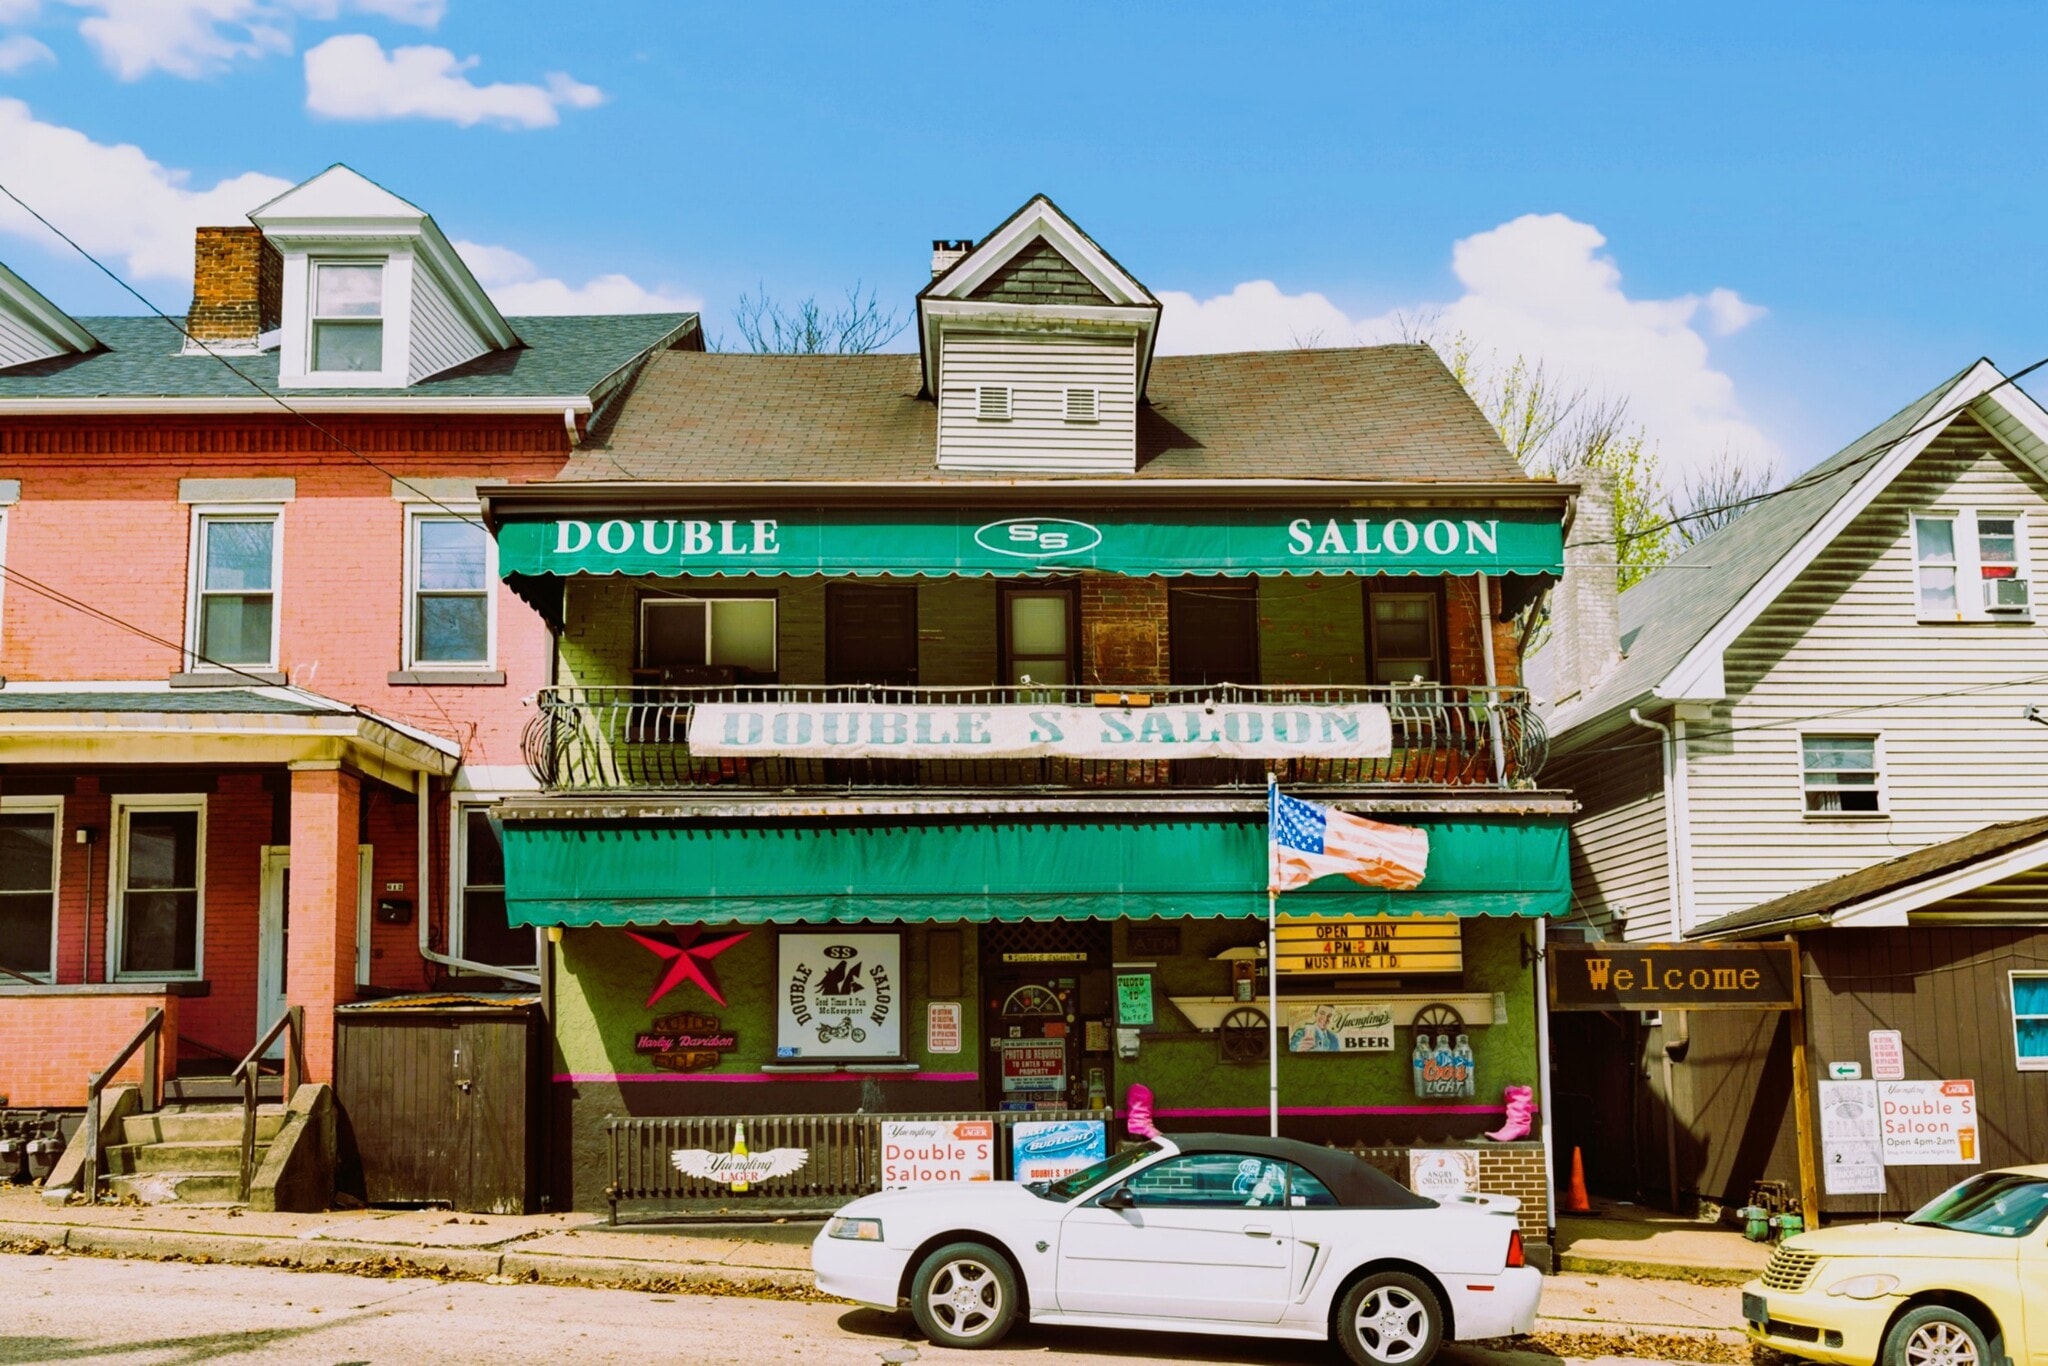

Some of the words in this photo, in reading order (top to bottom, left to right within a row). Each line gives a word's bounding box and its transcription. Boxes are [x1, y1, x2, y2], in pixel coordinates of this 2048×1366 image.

[553, 519, 780, 556] DOUBLE
[1008, 523, 1069, 550] SS
[1288, 518, 1499, 555] SALOON
[720, 711, 992, 745] DOUBLE
[1029, 711, 1064, 745] S
[1100, 711, 1361, 745] SALOON
[1316, 925, 1348, 938] OPEN
[1364, 925, 1397, 938] DAILY
[830, 947, 851, 957] SS
[1373, 941, 1390, 953] AM
[1304, 956, 1337, 969] MUST
[1342, 955, 1372, 968] HAVE
[1118, 977, 1144, 987] PHOTO
[1585, 958, 1760, 991] Welcome
[790, 962, 813, 1028] DOUBLE
[869, 964, 891, 1028] SALOON
[1129, 991, 1139, 1000] ID
[637, 1035, 674, 1053] Harley
[679, 1034, 733, 1047] Davidson
[1344, 1037, 1390, 1048] BEER
[1005, 1049, 1024, 1060] PHOTO
[1025, 1049, 1032, 1059] ID
[1033, 1049, 1062, 1059] REQUIRED
[1426, 1081, 1464, 1093] LIGHT
[1884, 1100, 1953, 1116] Double
[1961, 1099, 1971, 1114] S
[888, 1124, 937, 1139] Yuengling
[960, 1129, 987, 1137] LAGER
[1885, 1118, 1950, 1134] Saloon
[1029, 1140, 1056, 1151] BUD
[1055, 1132, 1092, 1147] LIGHT
[1886, 1137, 1911, 1148] Open
[1913, 1136, 1956, 1147] 4pm-2am
[886, 1144, 966, 1160] Double
[977, 1143, 988, 1160] S
[1835, 1154, 1842, 1164] 2
[704, 1154, 776, 1173] Yuengling
[720, 1171, 759, 1182] LAGER
[886, 1164, 961, 1182] Saloon
[1031, 1169, 1054, 1178] DOUBLE
